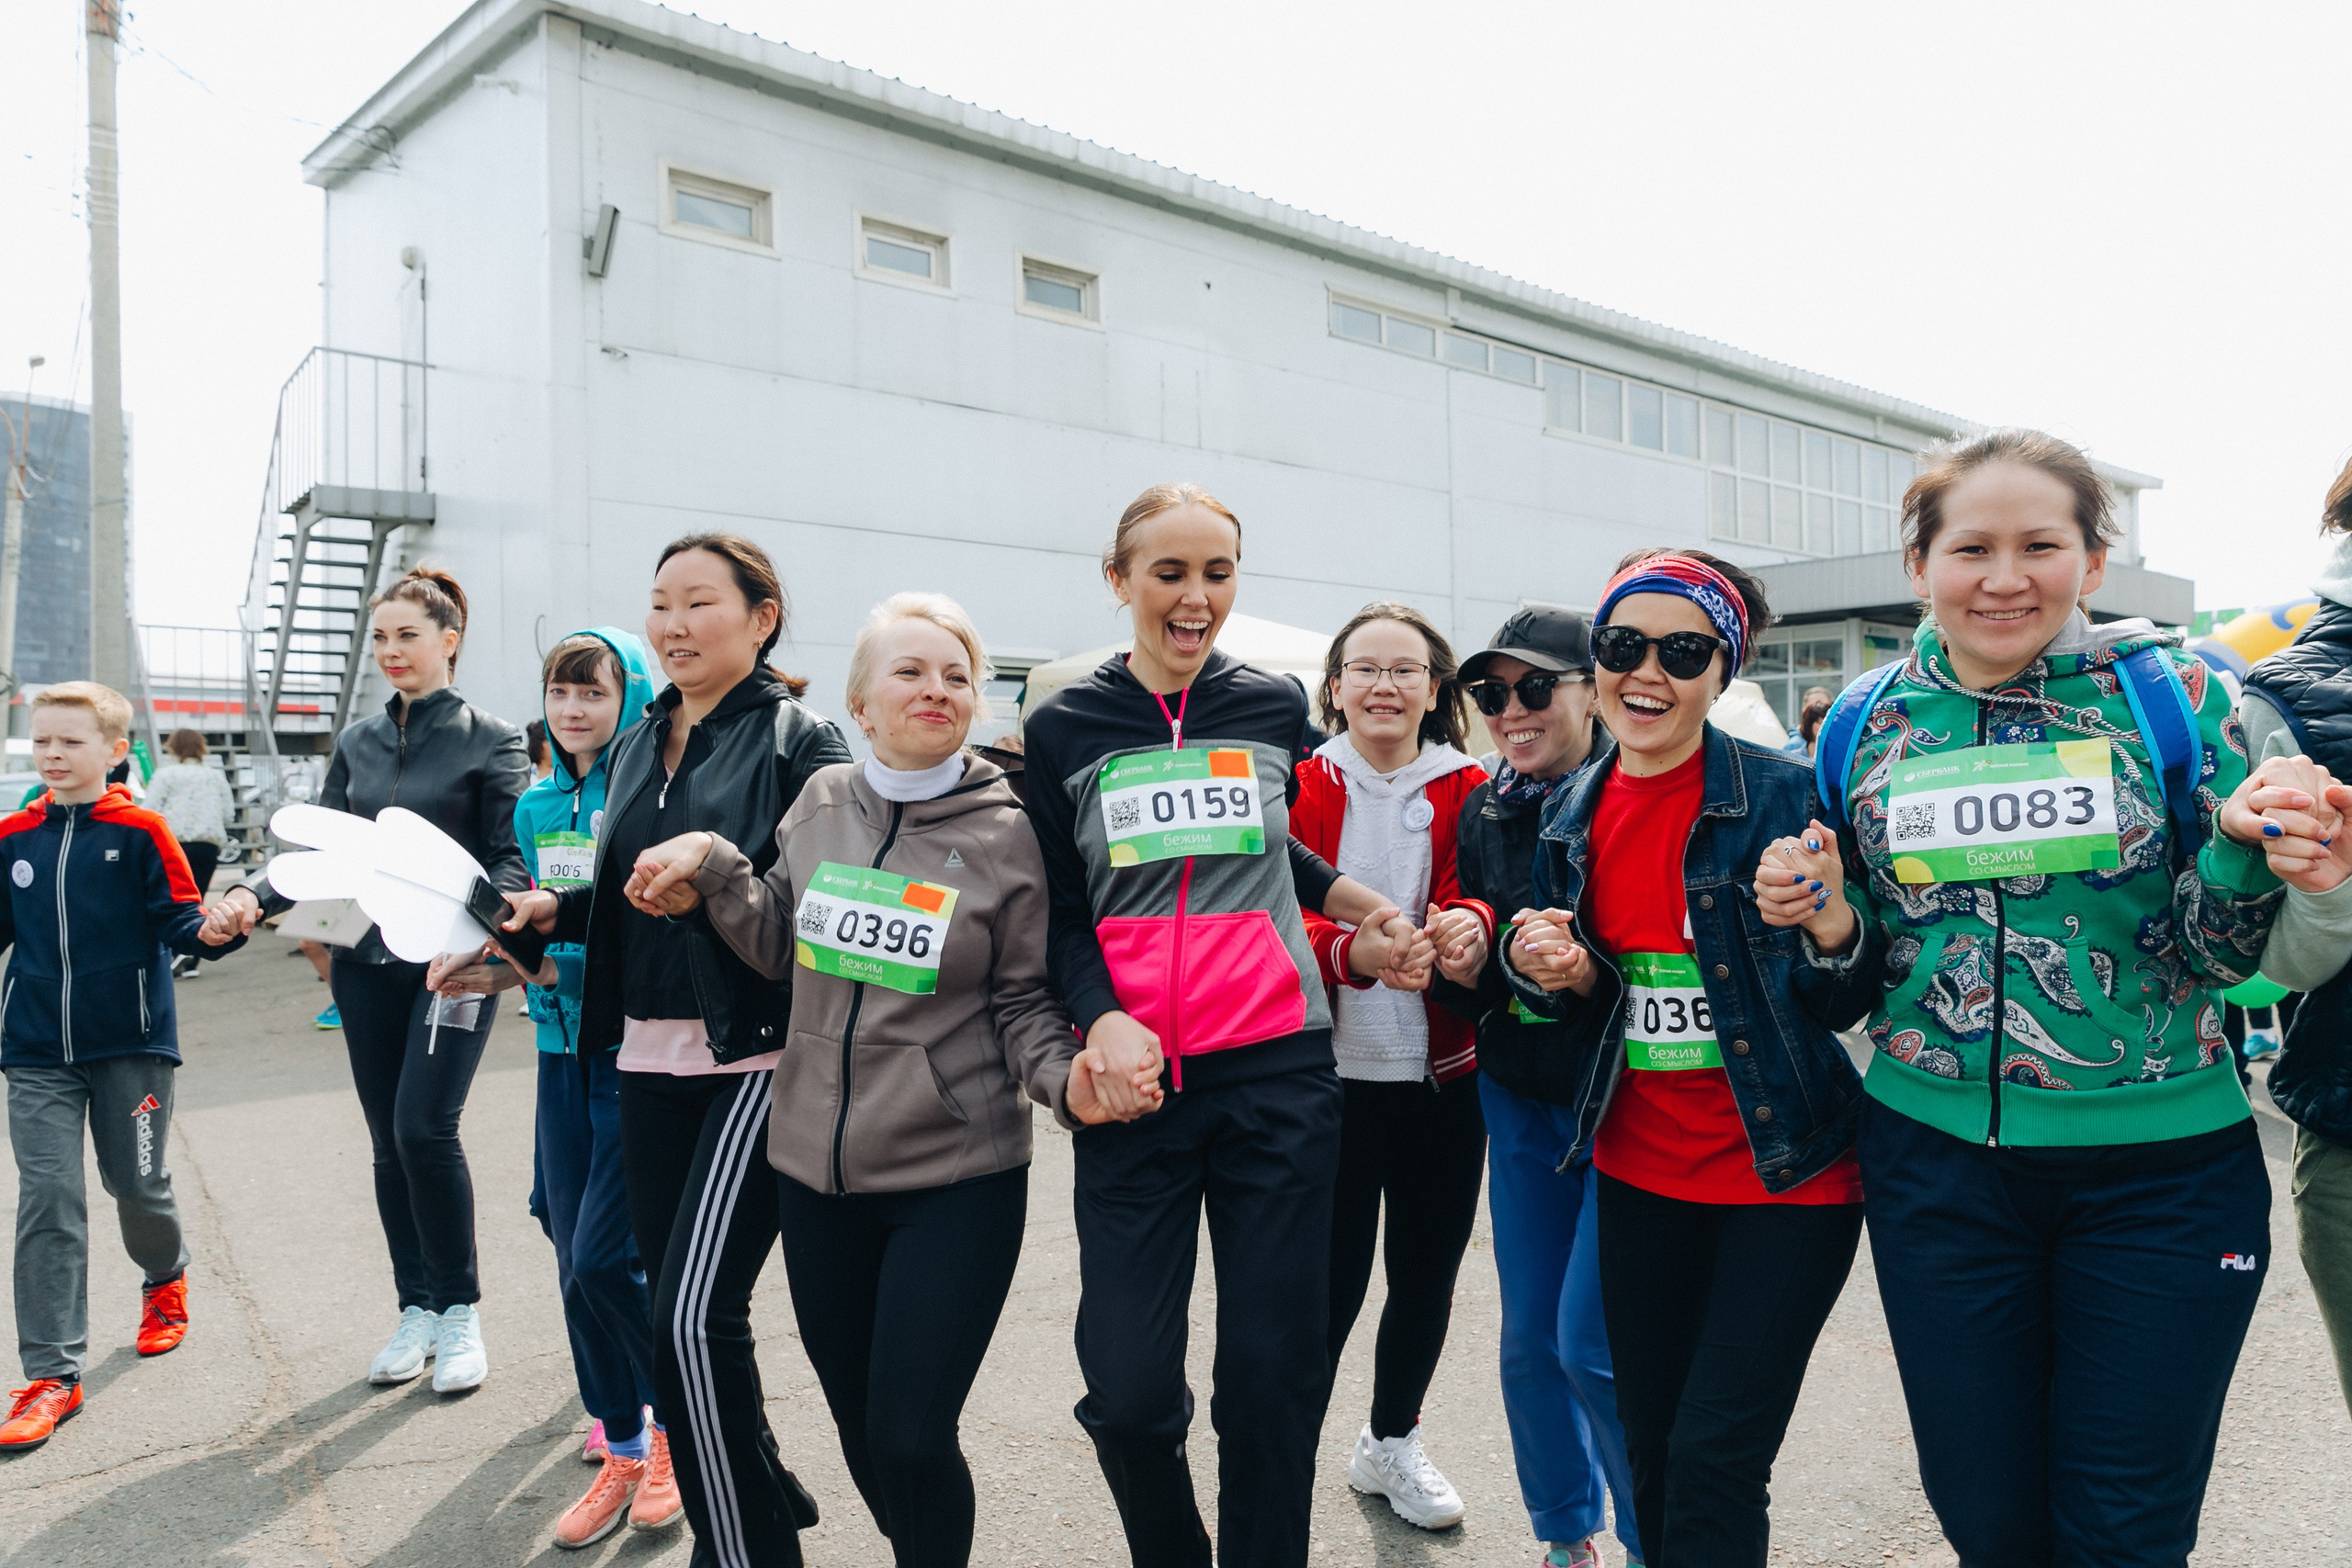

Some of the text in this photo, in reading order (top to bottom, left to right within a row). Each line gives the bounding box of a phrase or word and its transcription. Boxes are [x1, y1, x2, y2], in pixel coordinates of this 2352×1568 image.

[1917, 765, 1961, 778] СБЕРБАНК
[1151, 786, 1250, 823] 0159
[1954, 786, 2096, 836] 0083
[1163, 833, 1212, 847] бежим
[1966, 849, 2035, 866] бежим
[1984, 863, 2037, 874] СМЫСЛОМ
[836, 909, 933, 959] 0396
[839, 953, 883, 975] бежим
[1648, 1045, 1702, 1060] бежим
[1662, 1059, 1703, 1067] СМЫСЛОМ
[139, 1112, 153, 1177] adidas
[2220, 1253, 2256, 1271] FILA
